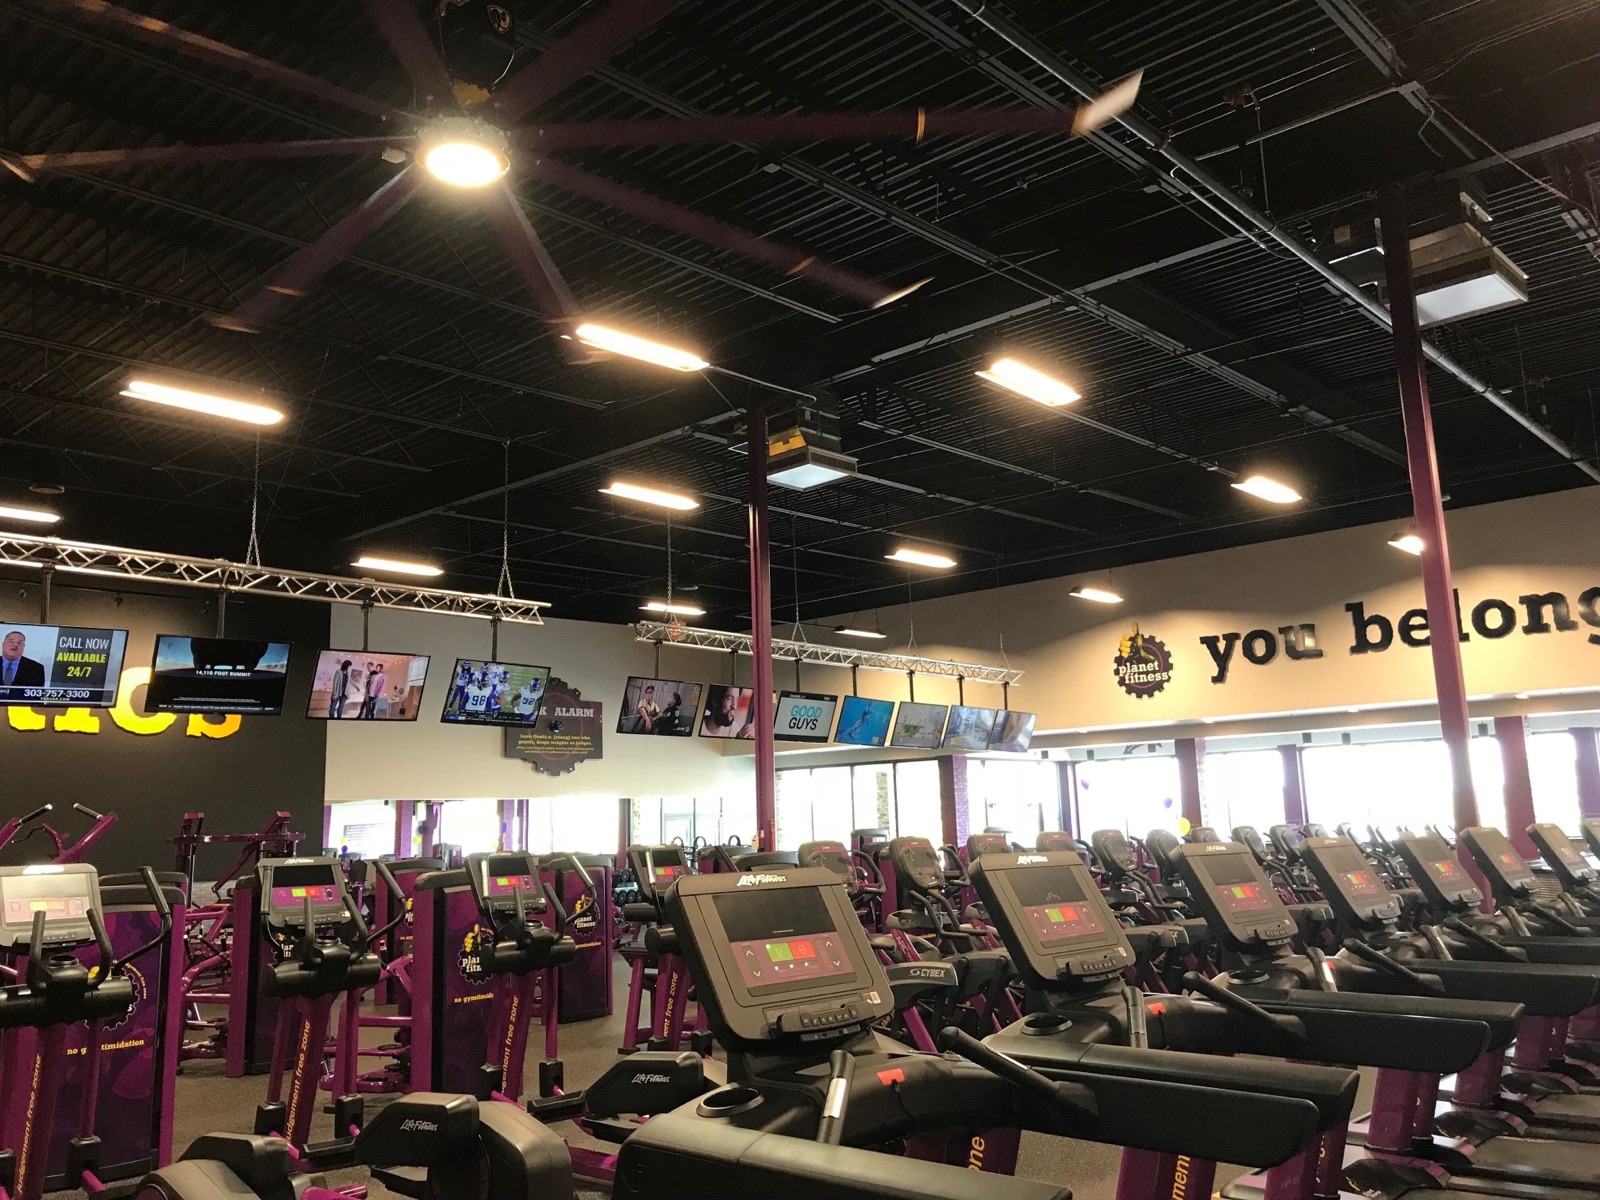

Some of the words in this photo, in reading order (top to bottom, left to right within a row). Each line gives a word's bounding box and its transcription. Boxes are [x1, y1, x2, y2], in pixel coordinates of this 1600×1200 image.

[59, 636, 83, 649] CALL
[85, 638, 109, 650] NOW
[56, 652, 107, 663] AVAILABLE
[1199, 623, 1323, 684] you
[66, 666, 92, 677] 24/7
[1118, 660, 1159, 677] planet
[1125, 671, 1169, 684] fitness
[23, 689, 90, 698] 303-757-3300
[471, 695, 487, 706] 98
[555, 707, 594, 717] ALARM
[790, 704, 823, 719] GOOD
[788, 717, 818, 730] GUYS
[462, 955, 480, 967] pla
[920, 968, 946, 977] CYBEX
[665, 997, 674, 1017] free
[670, 971, 678, 997] zone
[509, 995, 519, 1023] zone
[505, 1024, 514, 1046] free
[27, 1091, 36, 1119] free
[32, 1053, 41, 1089] zone
[286, 1079, 300, 1142] udgement
[295, 1052, 305, 1077] free
[301, 1019, 311, 1051] zone
[968, 1136, 985, 1171] ne
